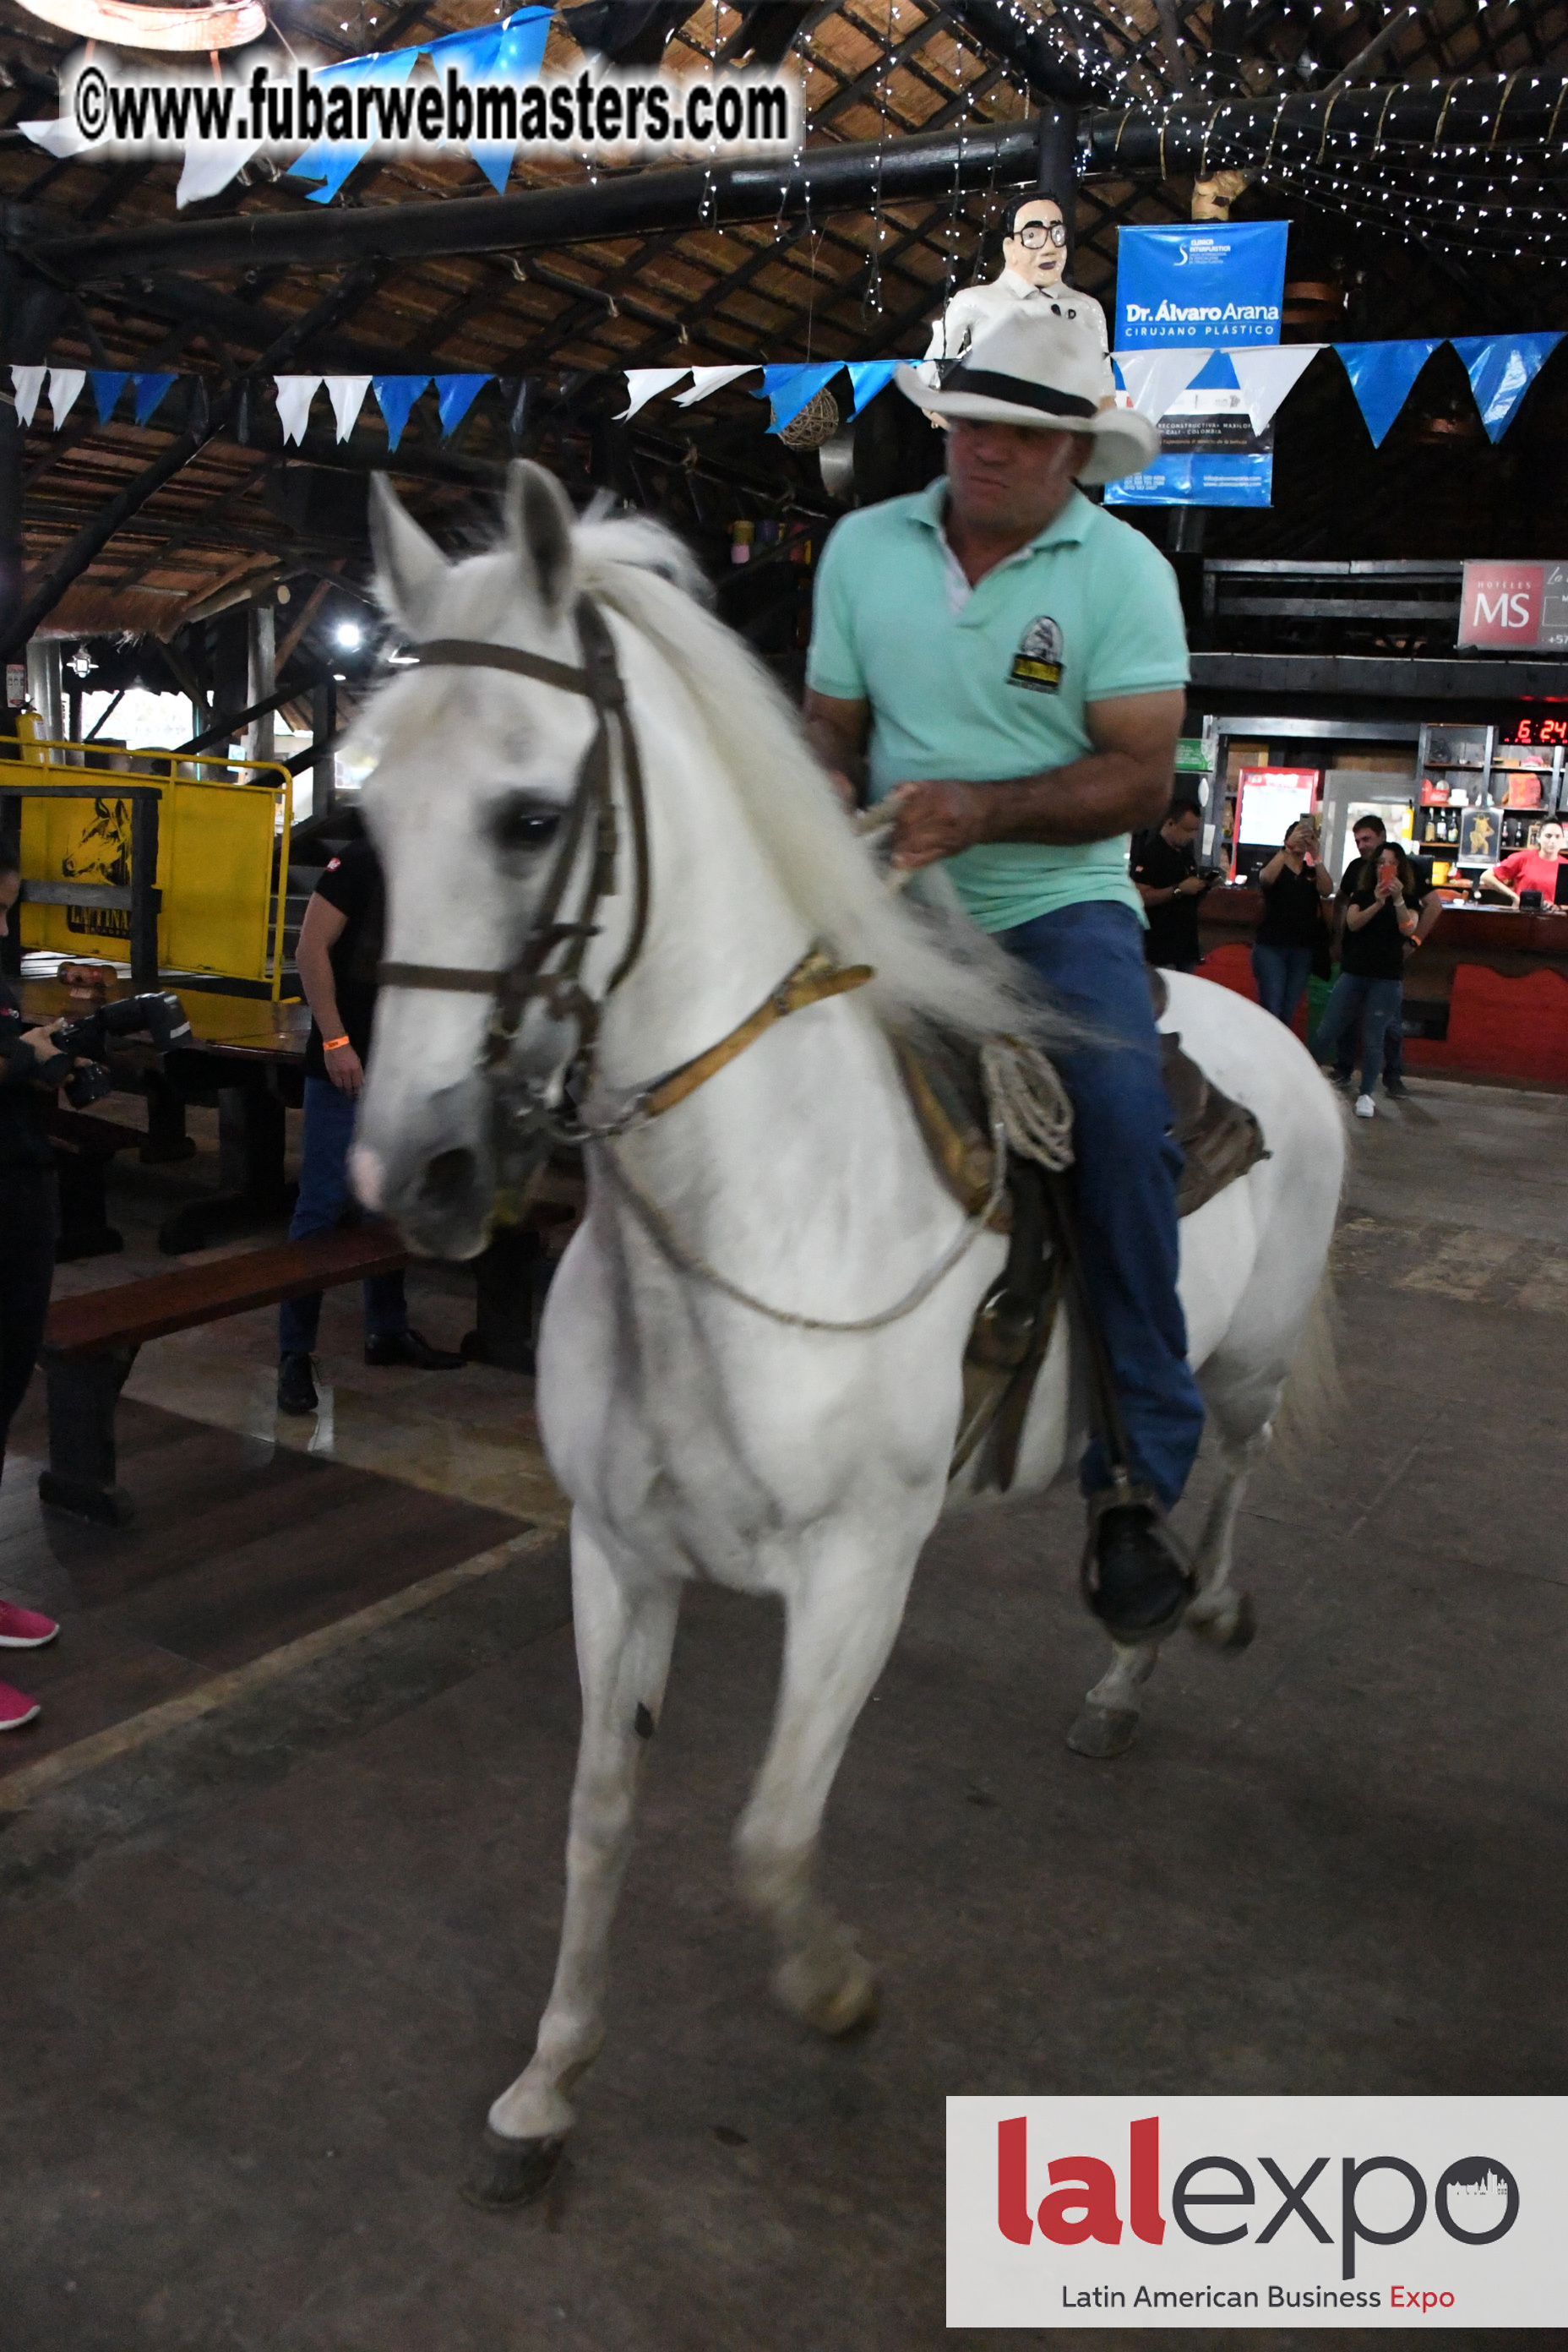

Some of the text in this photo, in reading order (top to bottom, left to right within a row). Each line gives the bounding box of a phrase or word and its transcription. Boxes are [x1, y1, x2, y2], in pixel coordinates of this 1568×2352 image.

[1126, 299, 1279, 322] Dr. Álvaro Arana
[1125, 324, 1274, 336] CIRUJANO PLÁSTICO
[1477, 581, 1531, 590] HOTELES
[1473, 593, 1530, 628] MS
